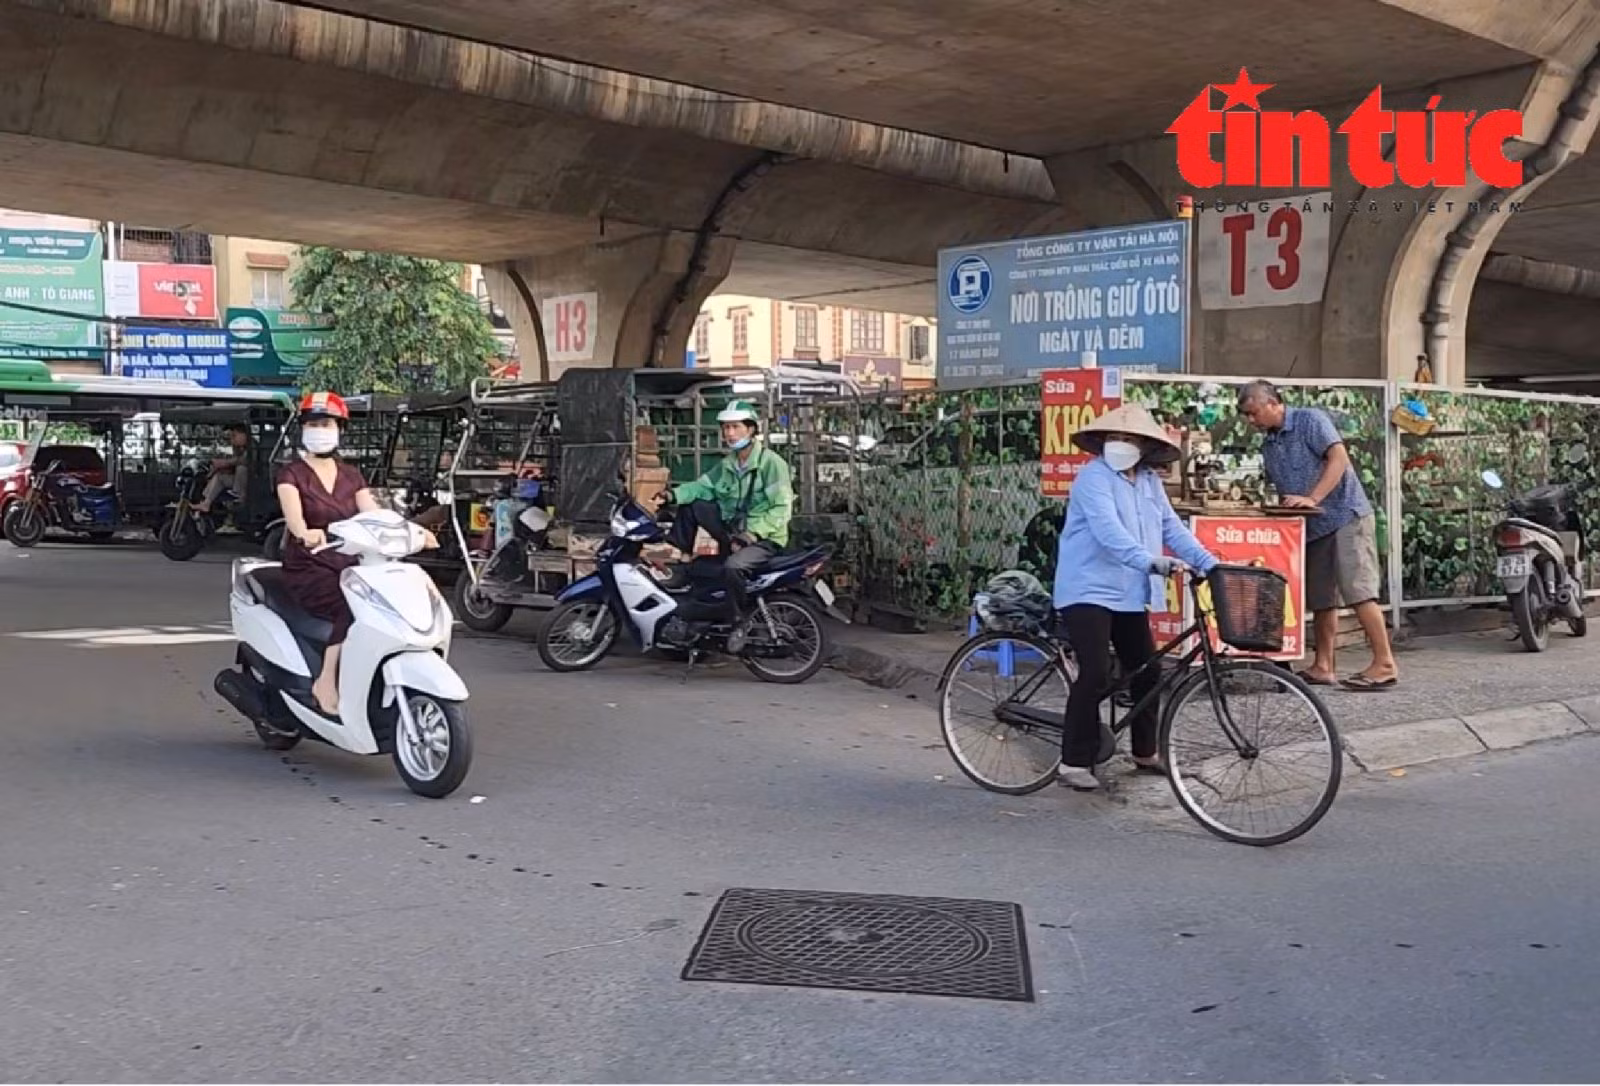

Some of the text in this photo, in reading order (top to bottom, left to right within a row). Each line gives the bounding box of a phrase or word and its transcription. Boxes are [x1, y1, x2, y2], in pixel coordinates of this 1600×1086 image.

[1016, 241, 1043, 259] TỔNG
[1046, 241, 1074, 255] CÔNG
[1078, 241, 1091, 251] TY
[1094, 235, 1117, 251] VẬN
[1139, 230, 1155, 243] HÀ
[1157, 229, 1179, 244] NỘI
[1011, 291, 1039, 324] NƠI
[1044, 283, 1102, 321] TRÔNG
[1107, 278, 1141, 318] GIỮ
[555, 300, 587, 352] H3
[1039, 327, 1079, 353] NGÀY
[1084, 325, 1103, 352] VÀ
[186, 334, 226, 348] MOBILE
[1045, 378, 1075, 394] Sửa
[1215, 524, 1281, 545] Sửa chữa
